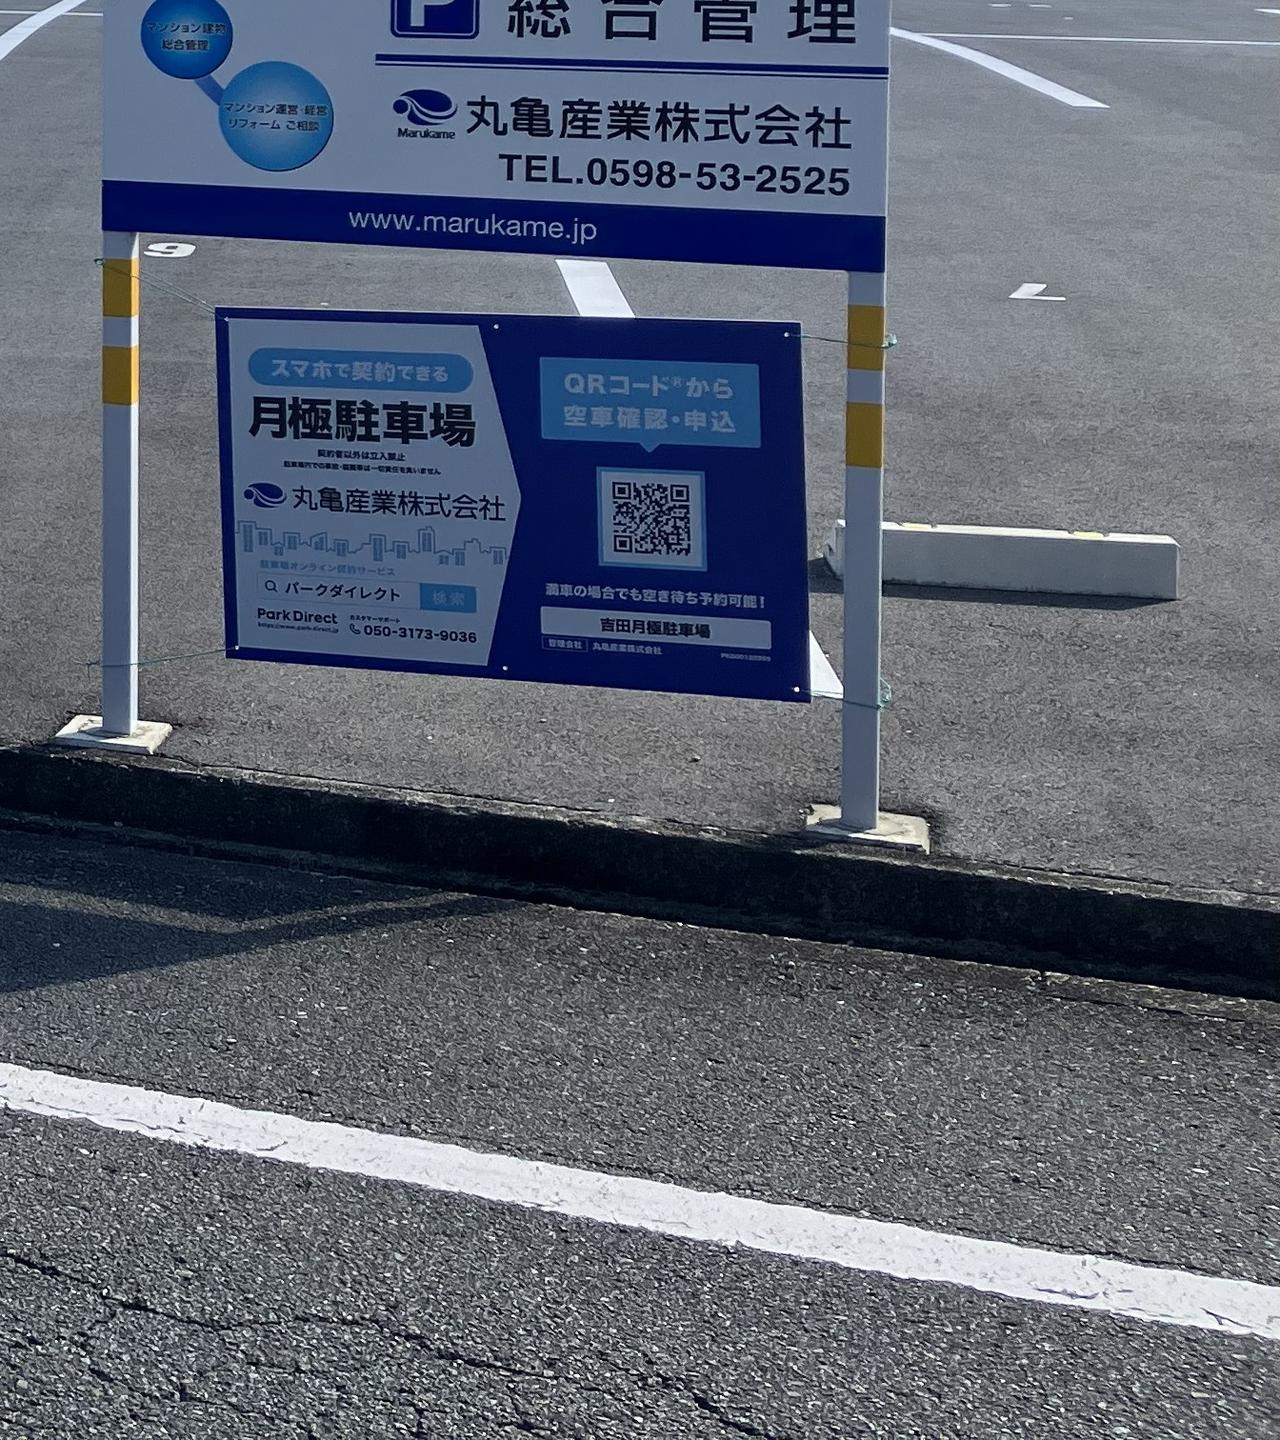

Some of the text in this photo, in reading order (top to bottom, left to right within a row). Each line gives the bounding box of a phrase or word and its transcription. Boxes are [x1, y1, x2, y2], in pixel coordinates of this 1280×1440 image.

[162, 39, 210, 51] 総合管理
[397, 127, 456, 140] Marukame
[466, 94, 852, 150] 丸亀産業株式会社
[498, 153, 850, 197] TEL.0598-53-2525
[348, 207, 598, 245] www.marukame.jp
[271, 359, 449, 383] スマホで契約できる
[248, 396, 476, 448] 月極駐車場
[563, 406, 736, 433] 空車確認・申込
[292, 485, 506, 523] 丸亀産業株式会社
[285, 581, 401, 602] パークダイレクト
[257, 607, 338, 625] Park Direct
[600, 617, 711, 639] 吉田月極駐車場
[363, 624, 478, 644] 050-3173-9036
